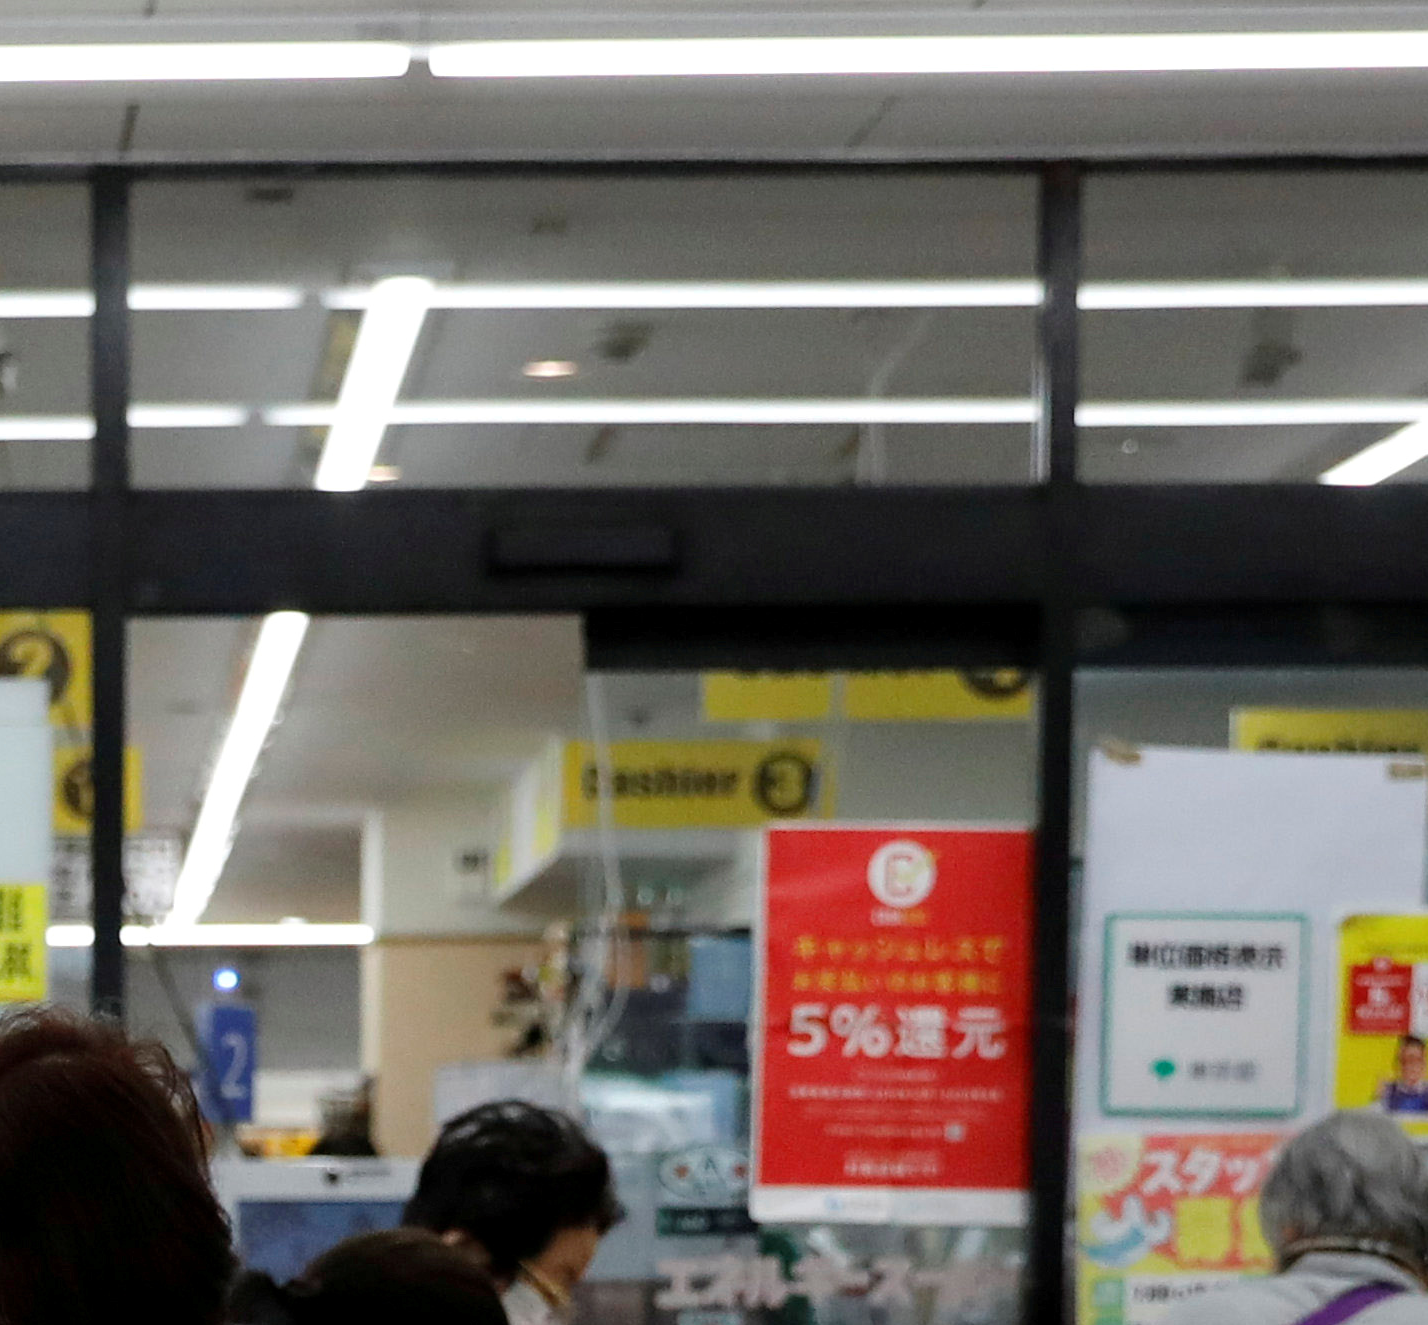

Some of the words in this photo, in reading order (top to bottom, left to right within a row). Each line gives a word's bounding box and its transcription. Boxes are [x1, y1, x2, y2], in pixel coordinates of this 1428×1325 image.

[787, 1001, 1006, 1060] 5%還元
[219, 1031, 248, 1099] 2
[1142, 1146, 1276, 1194] スタッ
